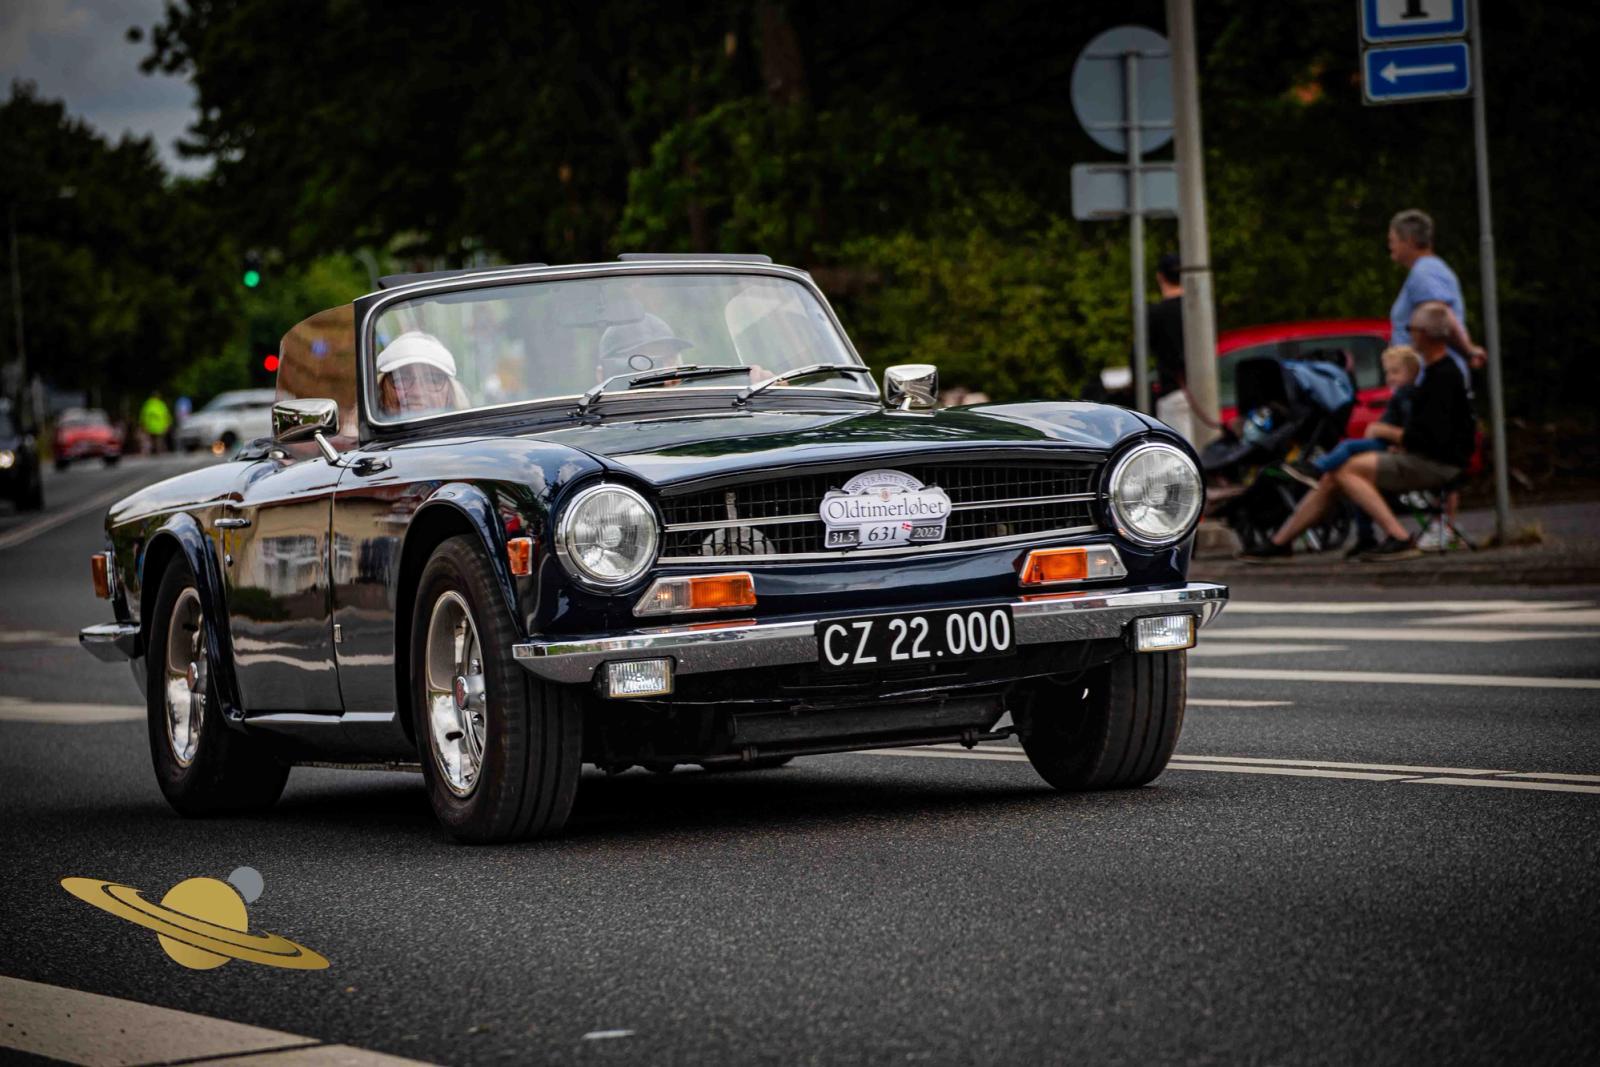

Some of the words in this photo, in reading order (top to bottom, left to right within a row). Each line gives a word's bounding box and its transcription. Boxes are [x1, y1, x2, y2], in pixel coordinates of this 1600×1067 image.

[828, 498, 945, 519] Oldtimerløbet
[868, 526, 897, 541] 631
[914, 527, 941, 538] 2025
[824, 621, 877, 666] CZ
[888, 609, 1010, 660] 22.000
